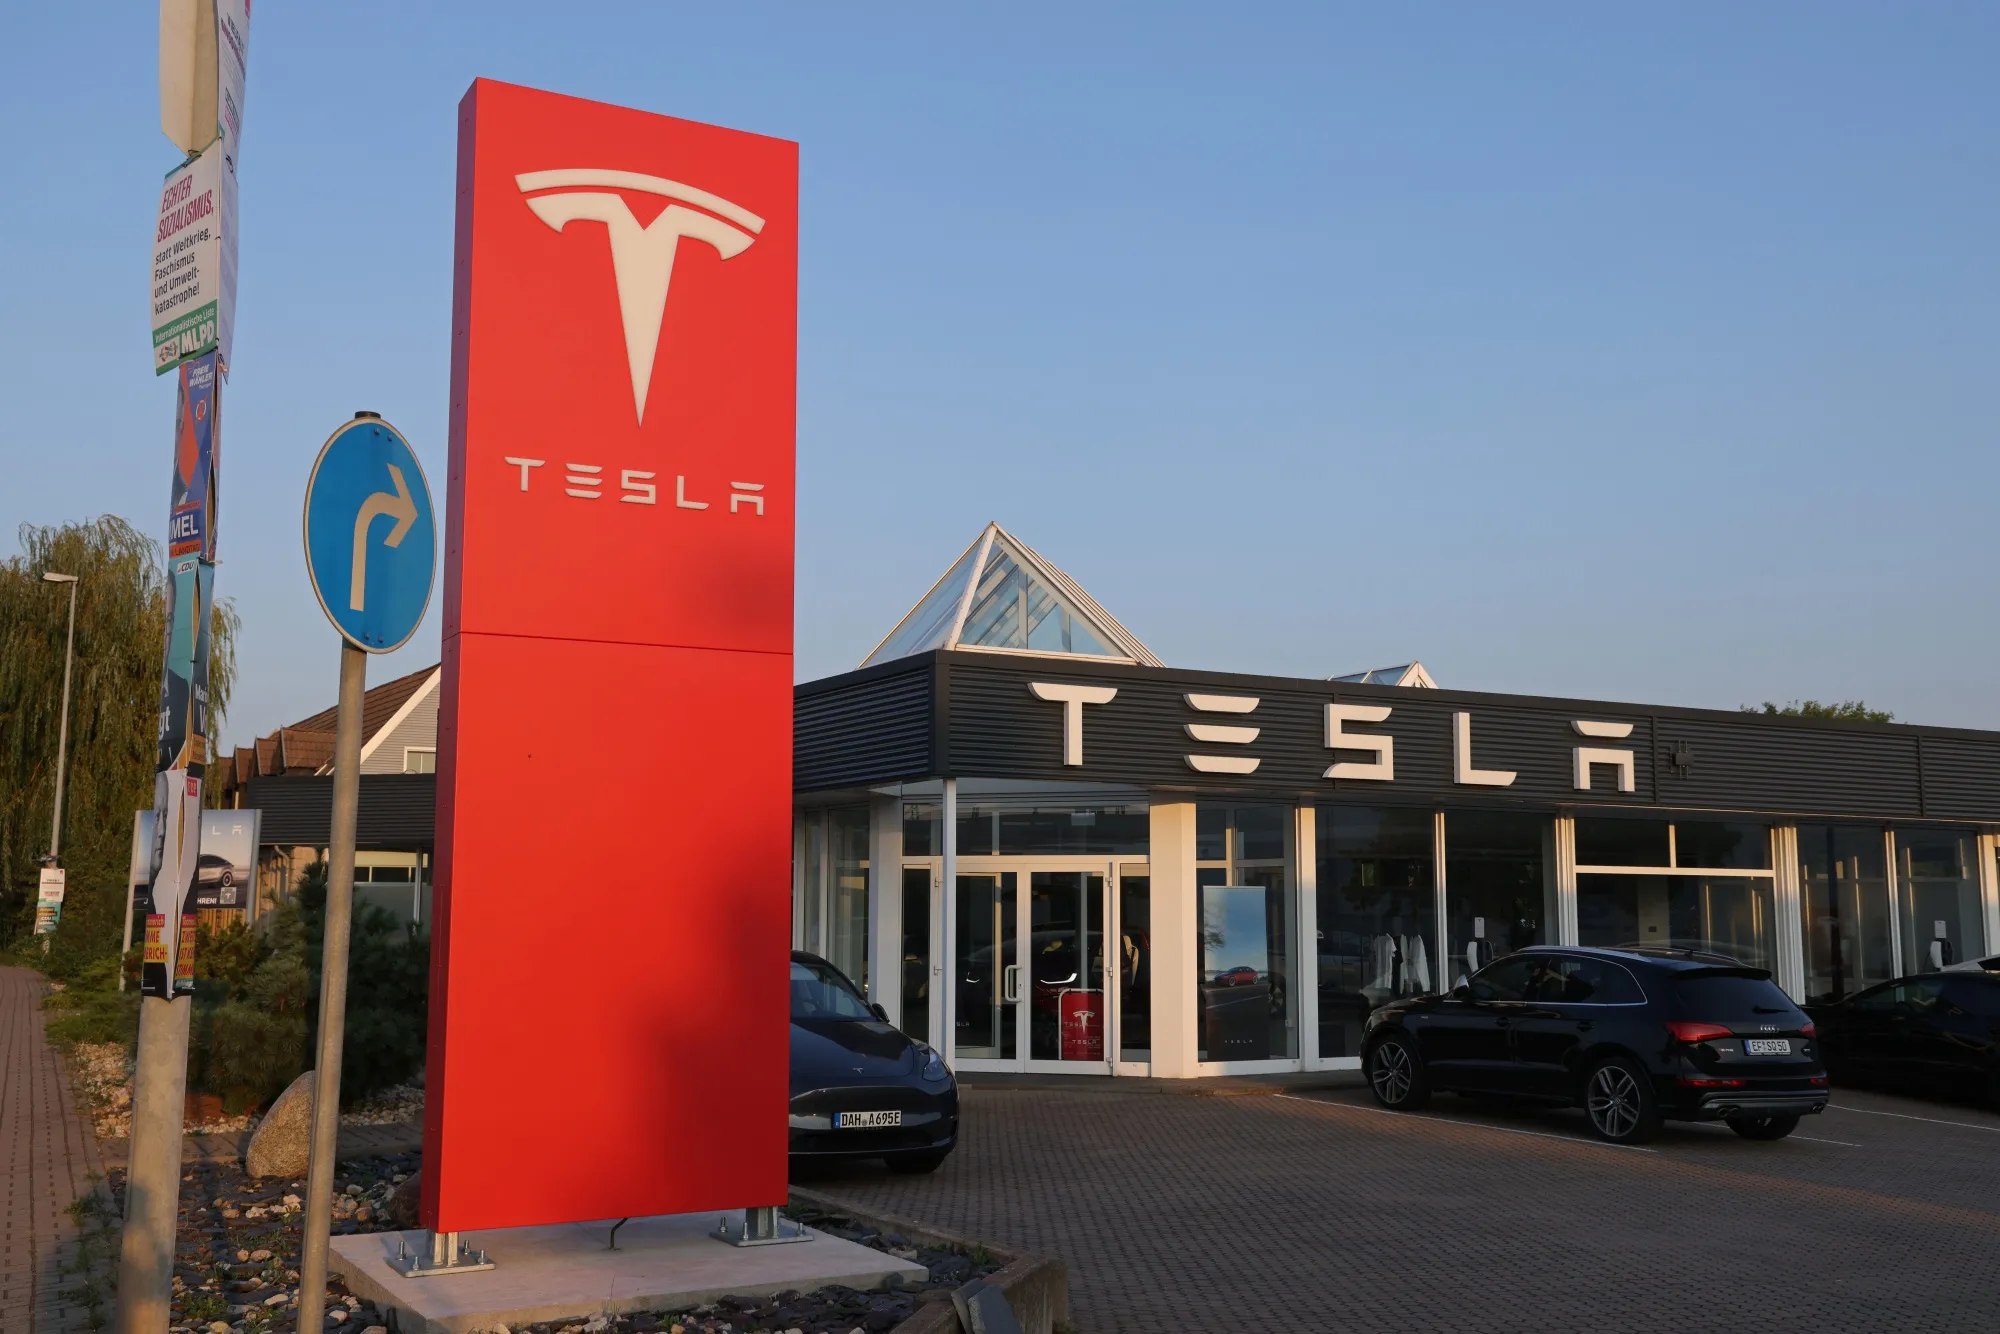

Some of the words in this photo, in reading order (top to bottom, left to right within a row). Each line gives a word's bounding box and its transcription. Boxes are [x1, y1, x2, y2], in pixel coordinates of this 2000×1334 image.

[162, 174, 192, 213] ECHTER
[157, 189, 214, 243] SOZIALISMUS,
[155, 246, 171, 265] statt
[173, 228, 211, 255] Weltkrieg,
[154, 252, 195, 282] Faschismus
[154, 281, 168, 298] und
[169, 266, 200, 290] Umwelt-
[155, 282, 200, 315] katastrophe!
[181, 320, 215, 354] MLPD
[504, 456, 764, 516] TESLA
[181, 561, 194, 572] CDU
[1027, 681, 1635, 793] TESLA
[841, 1113, 861, 1127] DAH
